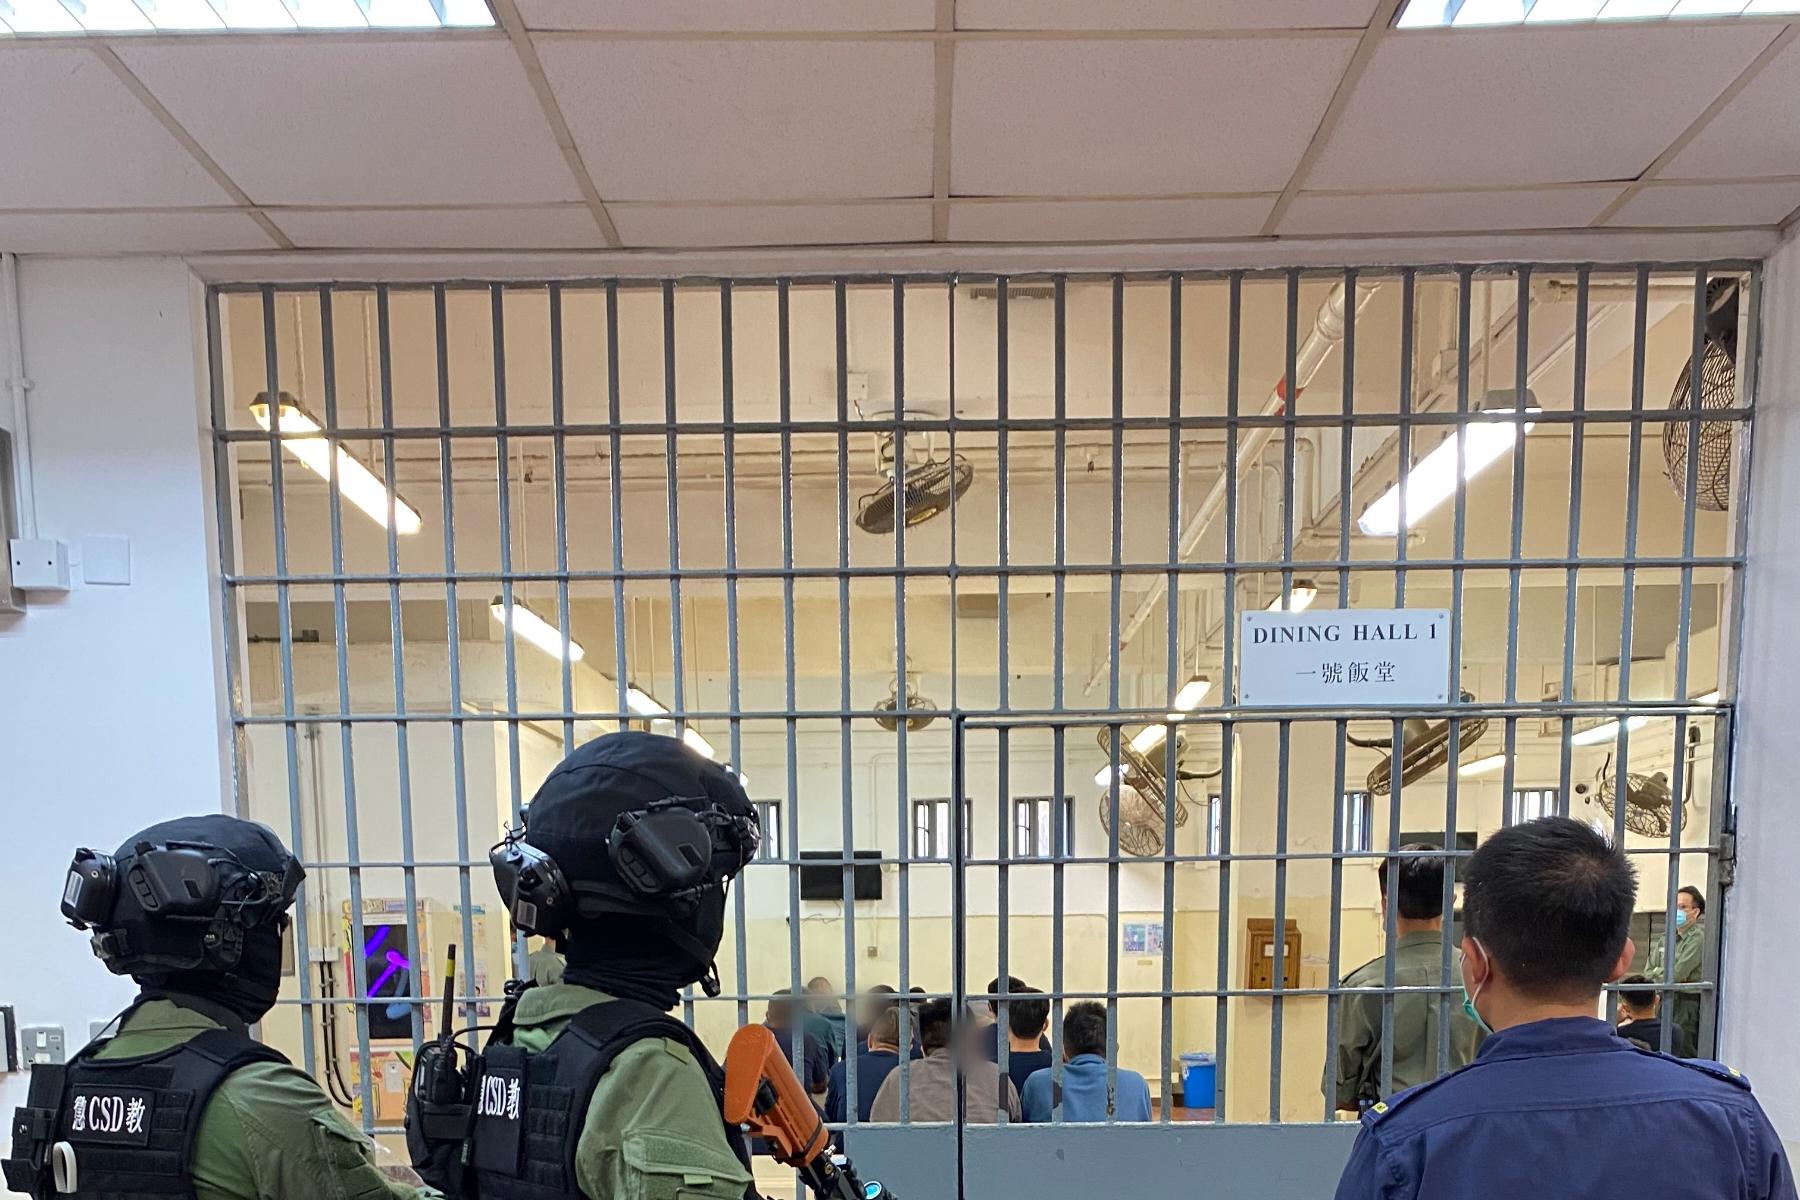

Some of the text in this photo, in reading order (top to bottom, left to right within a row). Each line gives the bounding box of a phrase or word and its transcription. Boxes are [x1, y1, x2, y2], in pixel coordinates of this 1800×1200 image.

[1253, 623, 1437, 644] DINING HALL 1
[1295, 661, 1396, 684] 一號飯堂
